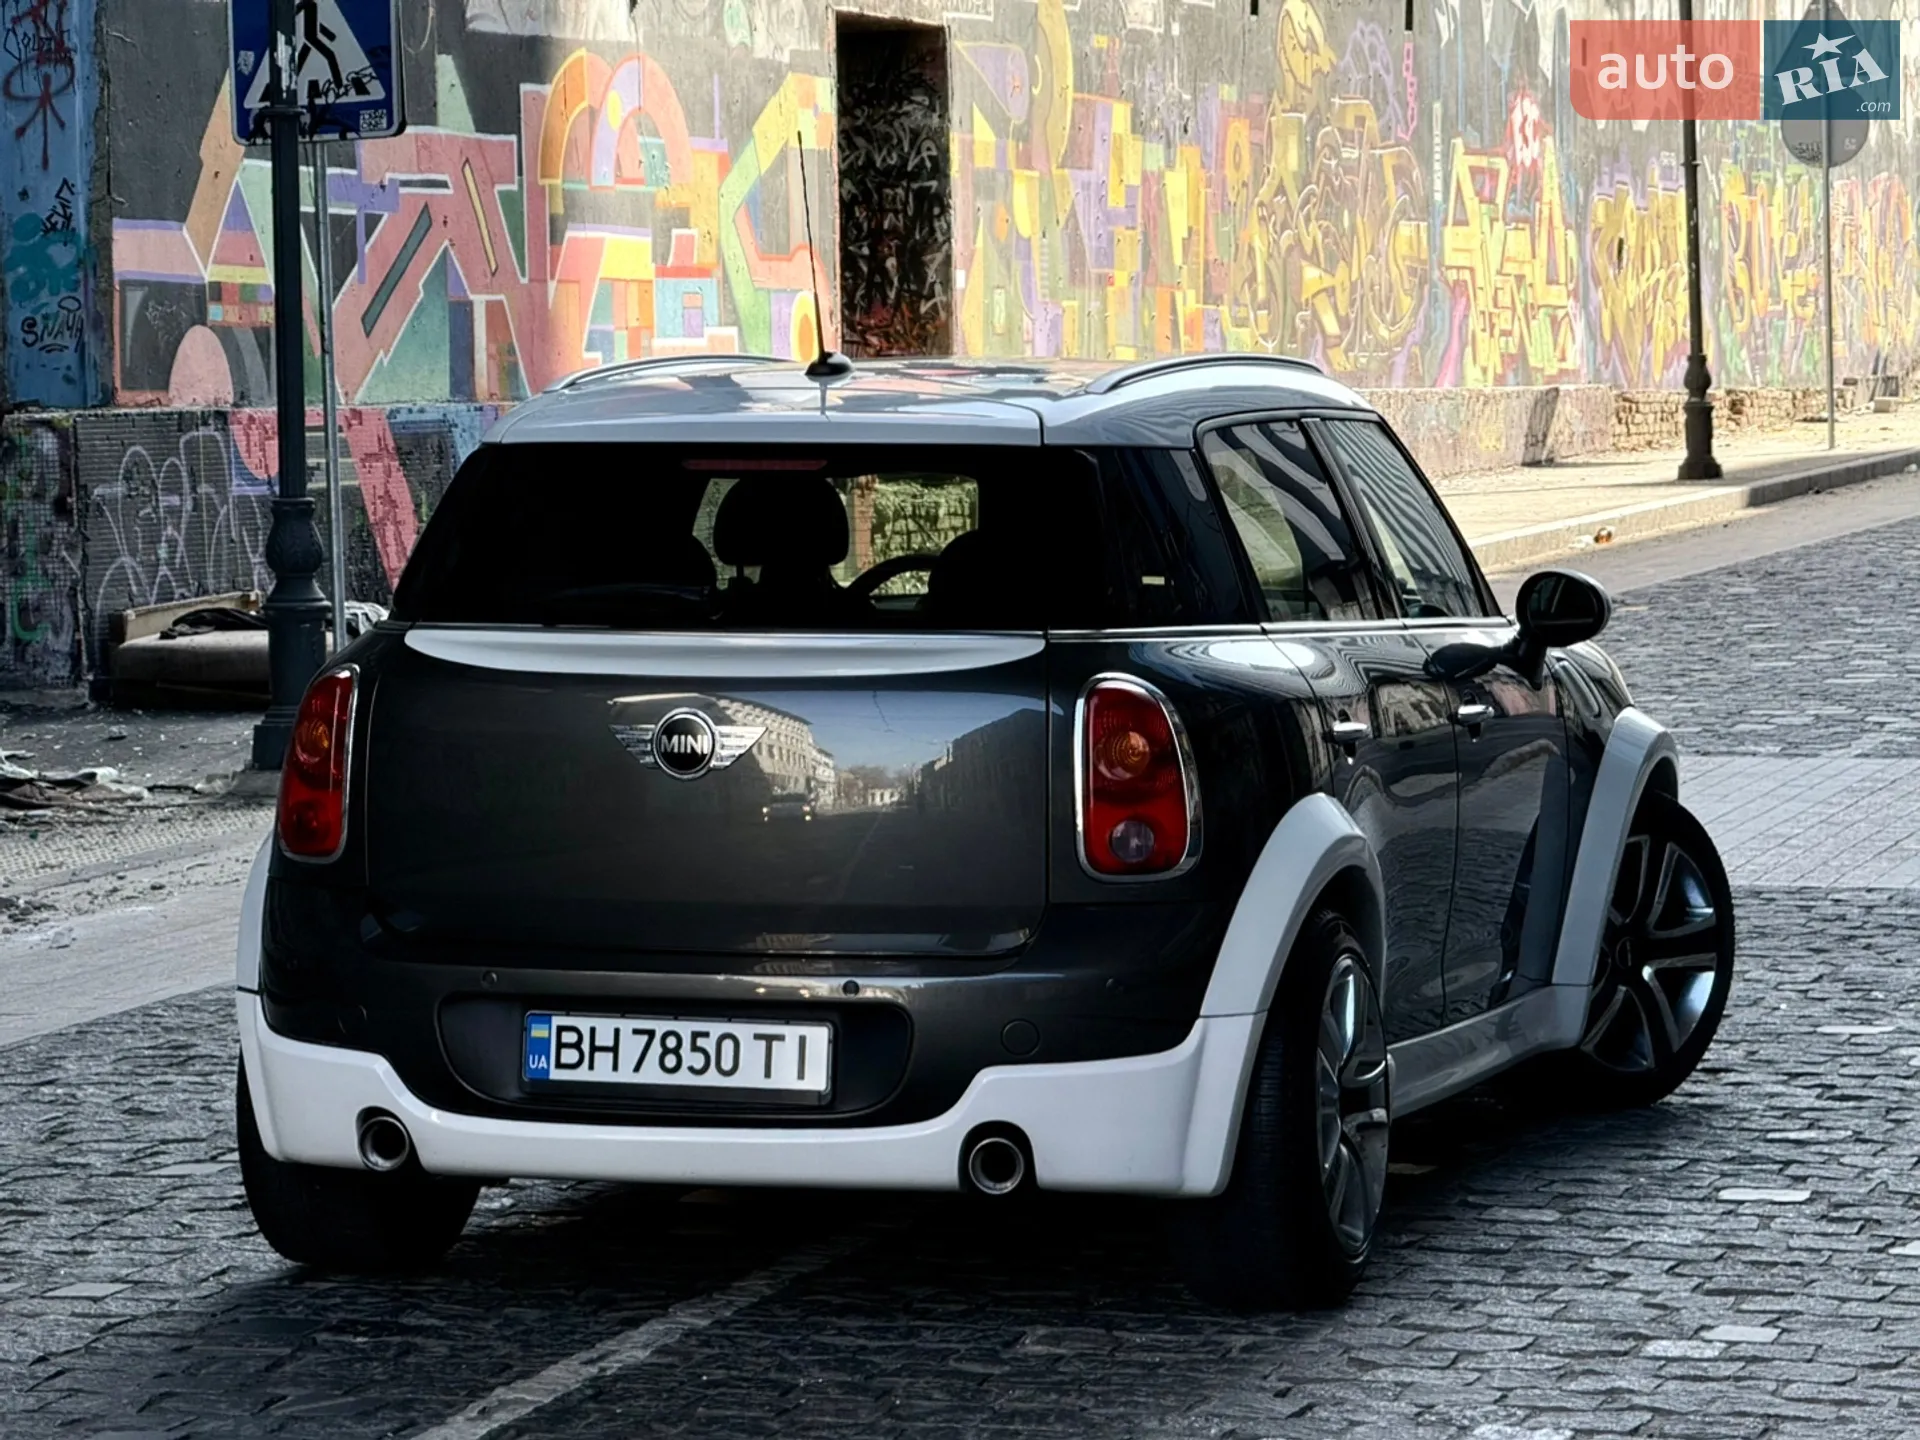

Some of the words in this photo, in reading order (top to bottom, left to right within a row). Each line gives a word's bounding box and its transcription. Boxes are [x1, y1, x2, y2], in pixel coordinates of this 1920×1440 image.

[660, 734, 709, 755] MINI
[528, 1054, 548, 1070] UA
[554, 1024, 621, 1072] BH
[631, 1028, 741, 1077] 7850
[753, 1033, 807, 1081] TI
